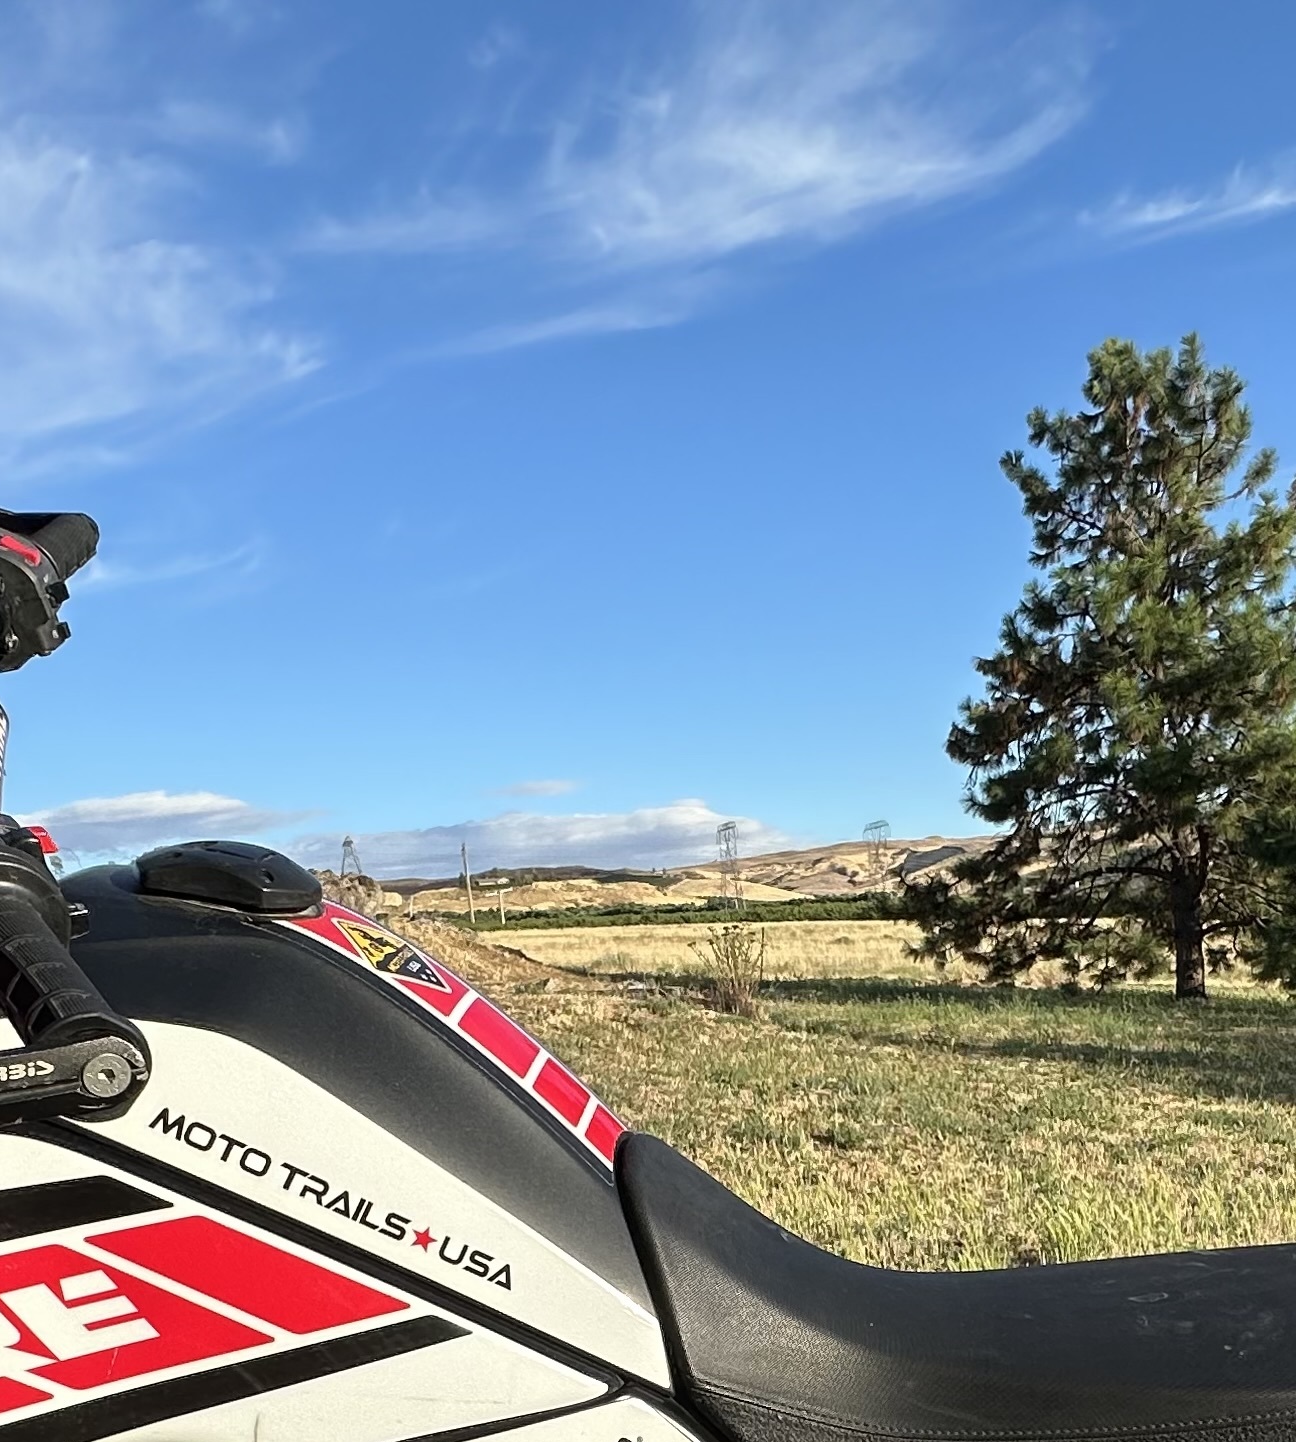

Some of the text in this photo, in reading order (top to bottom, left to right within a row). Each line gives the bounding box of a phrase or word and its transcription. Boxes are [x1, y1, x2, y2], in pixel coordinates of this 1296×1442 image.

[148, 1107, 512, 1291] MOTO TRAILS USA
